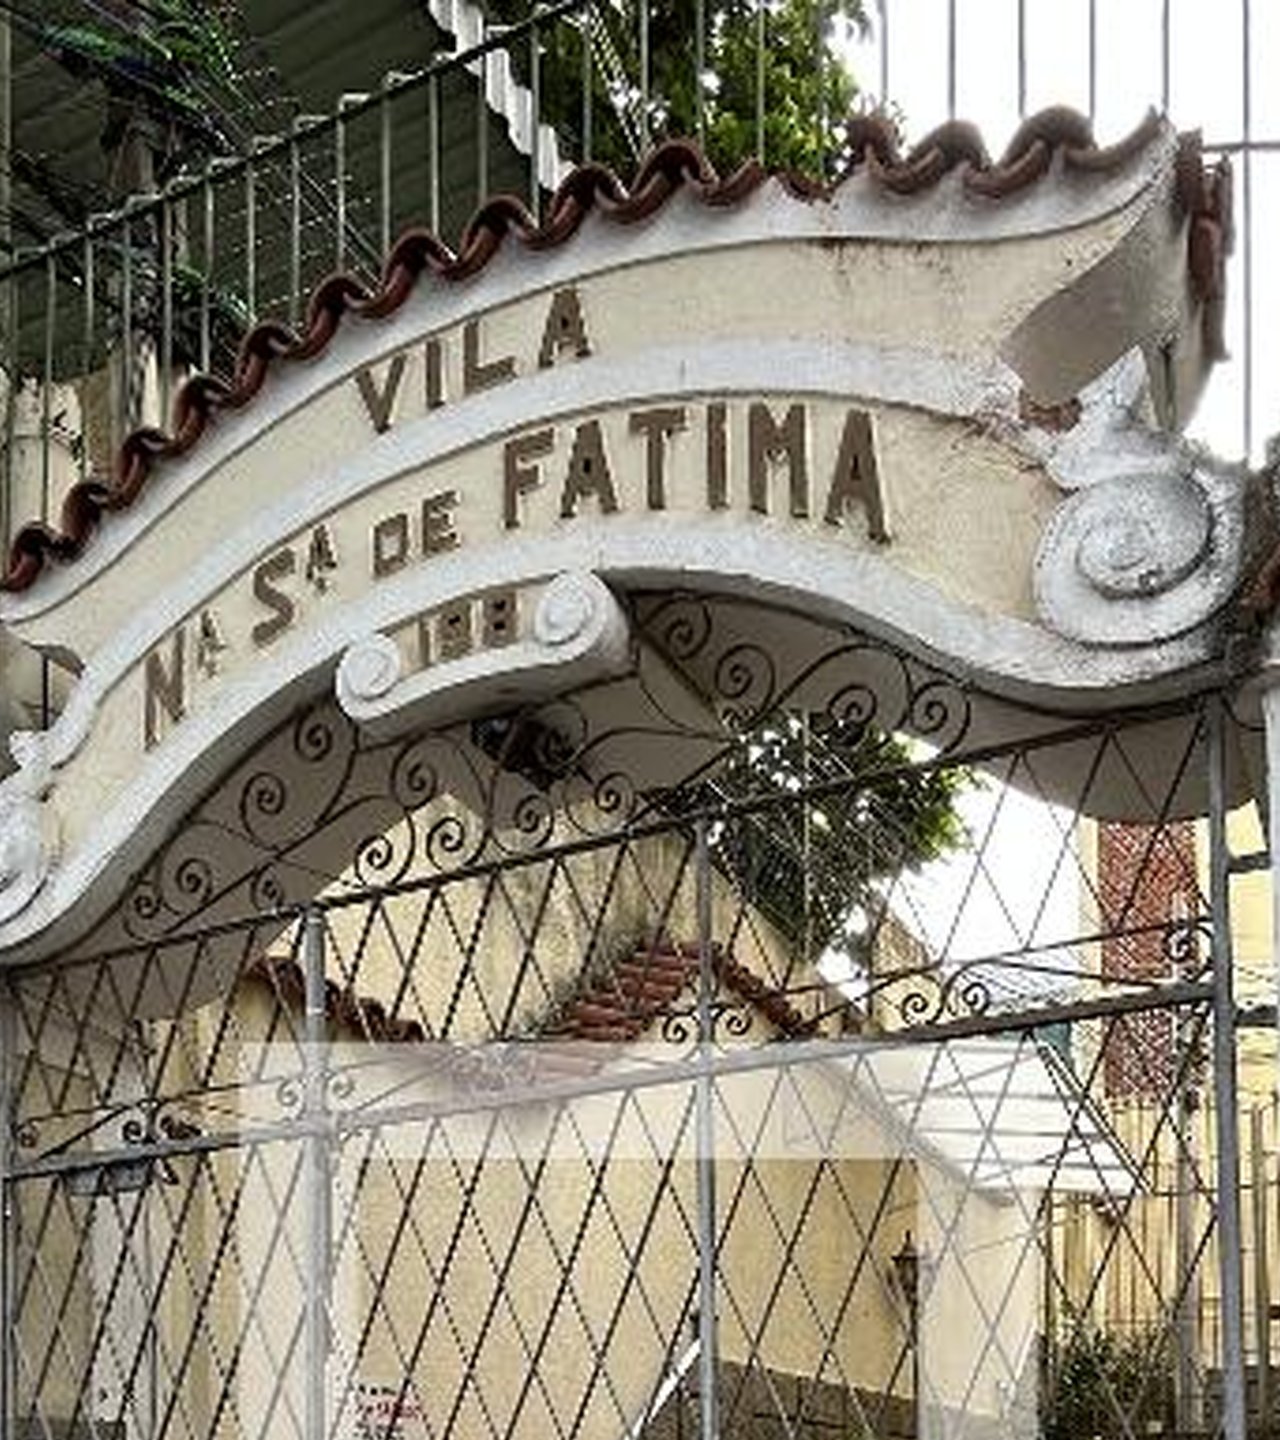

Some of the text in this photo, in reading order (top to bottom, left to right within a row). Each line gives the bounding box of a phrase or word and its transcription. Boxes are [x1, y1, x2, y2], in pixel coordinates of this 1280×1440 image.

[355, 285, 592, 435] VILA
[372, 490, 461, 580] DE
[503, 402, 893, 546] FATIMA
